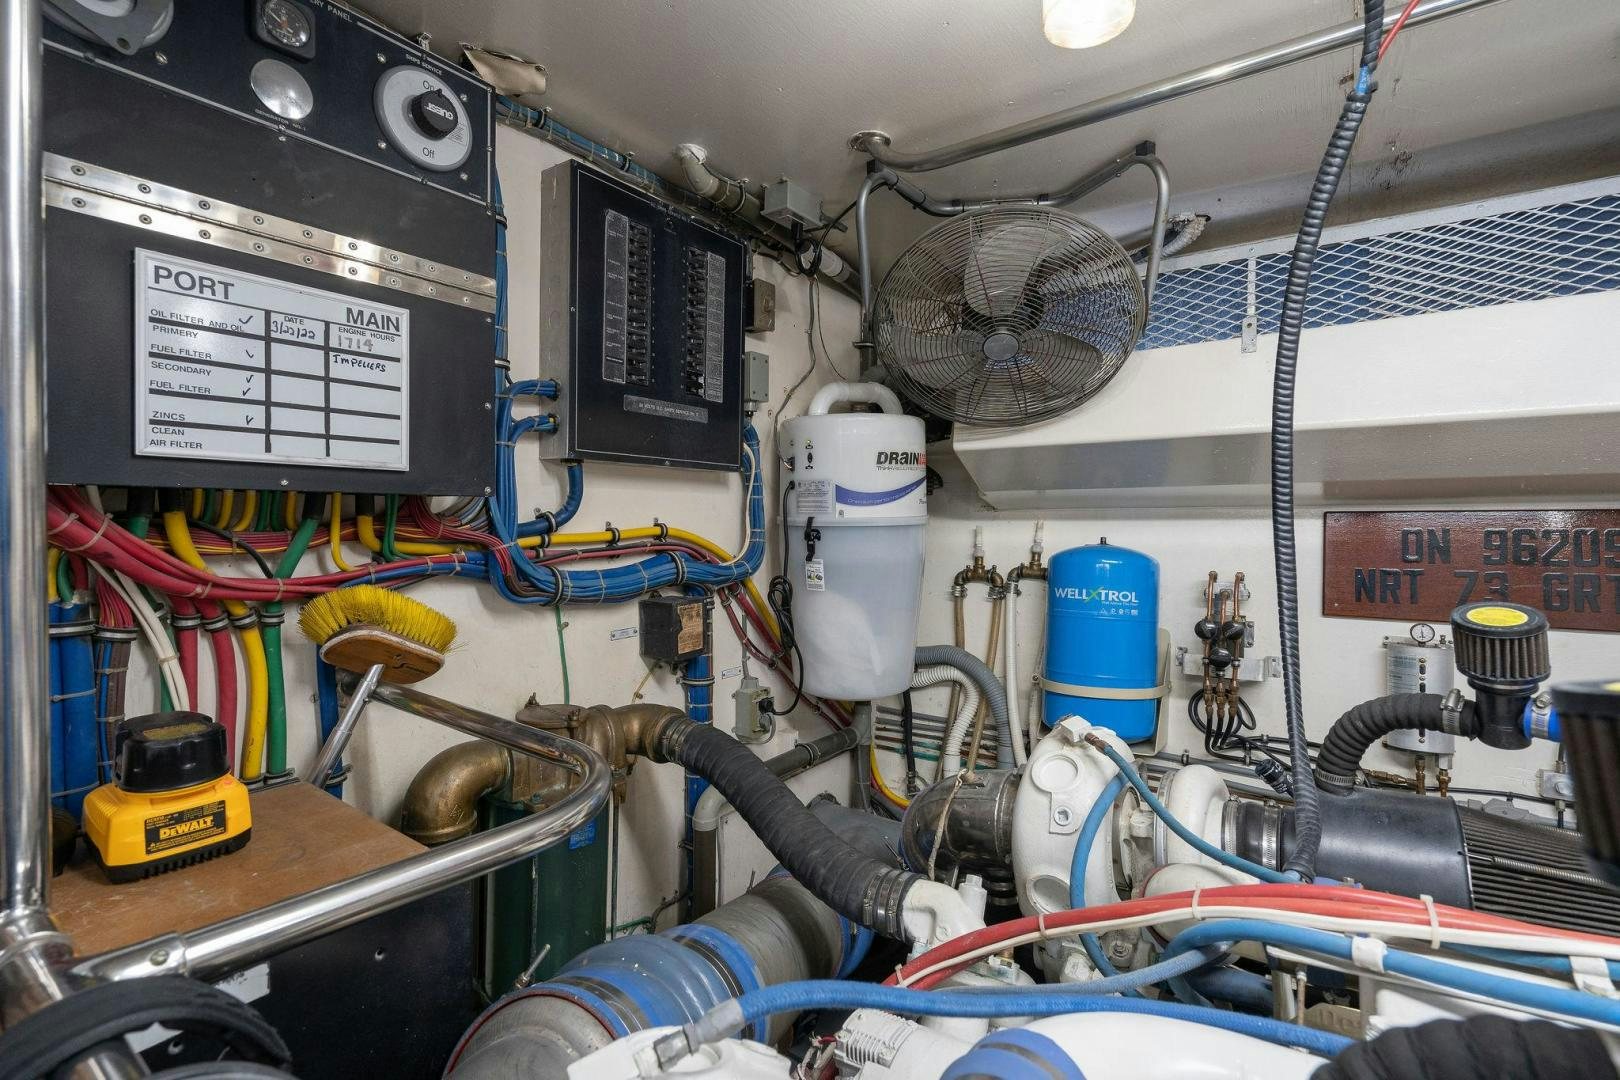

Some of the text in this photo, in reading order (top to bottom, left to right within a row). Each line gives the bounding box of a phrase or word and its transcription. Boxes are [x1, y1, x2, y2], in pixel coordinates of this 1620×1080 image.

[327, 5, 352, 22] PANEL
[421, 61, 442, 76] SERVICE
[423, 80, 435, 91] On
[427, 102, 454, 121] GUEST
[422, 146, 435, 159] Off
[154, 265, 235, 300] PORT
[150, 308, 245, 333] OIL FILTER AND OIL
[284, 315, 305, 326] DATE
[346, 307, 400, 333] MAIN
[152, 324, 198, 339] PRIMERY
[338, 326, 396, 343] ENGINE HOURS
[338, 334, 374, 352] 1714
[150, 343, 212, 360] FUEL FILTER
[151, 360, 212, 376] SECONDARY
[149, 379, 211, 395] FUEL FILTER
[152, 410, 186, 421] ZINCS
[151, 426, 185, 436] CLEAN
[149, 439, 203, 450] AIR FILTER
[1400, 527, 1451, 564] ON
[1353, 567, 1425, 605] NRT
[1453, 570, 1511, 608] 73
